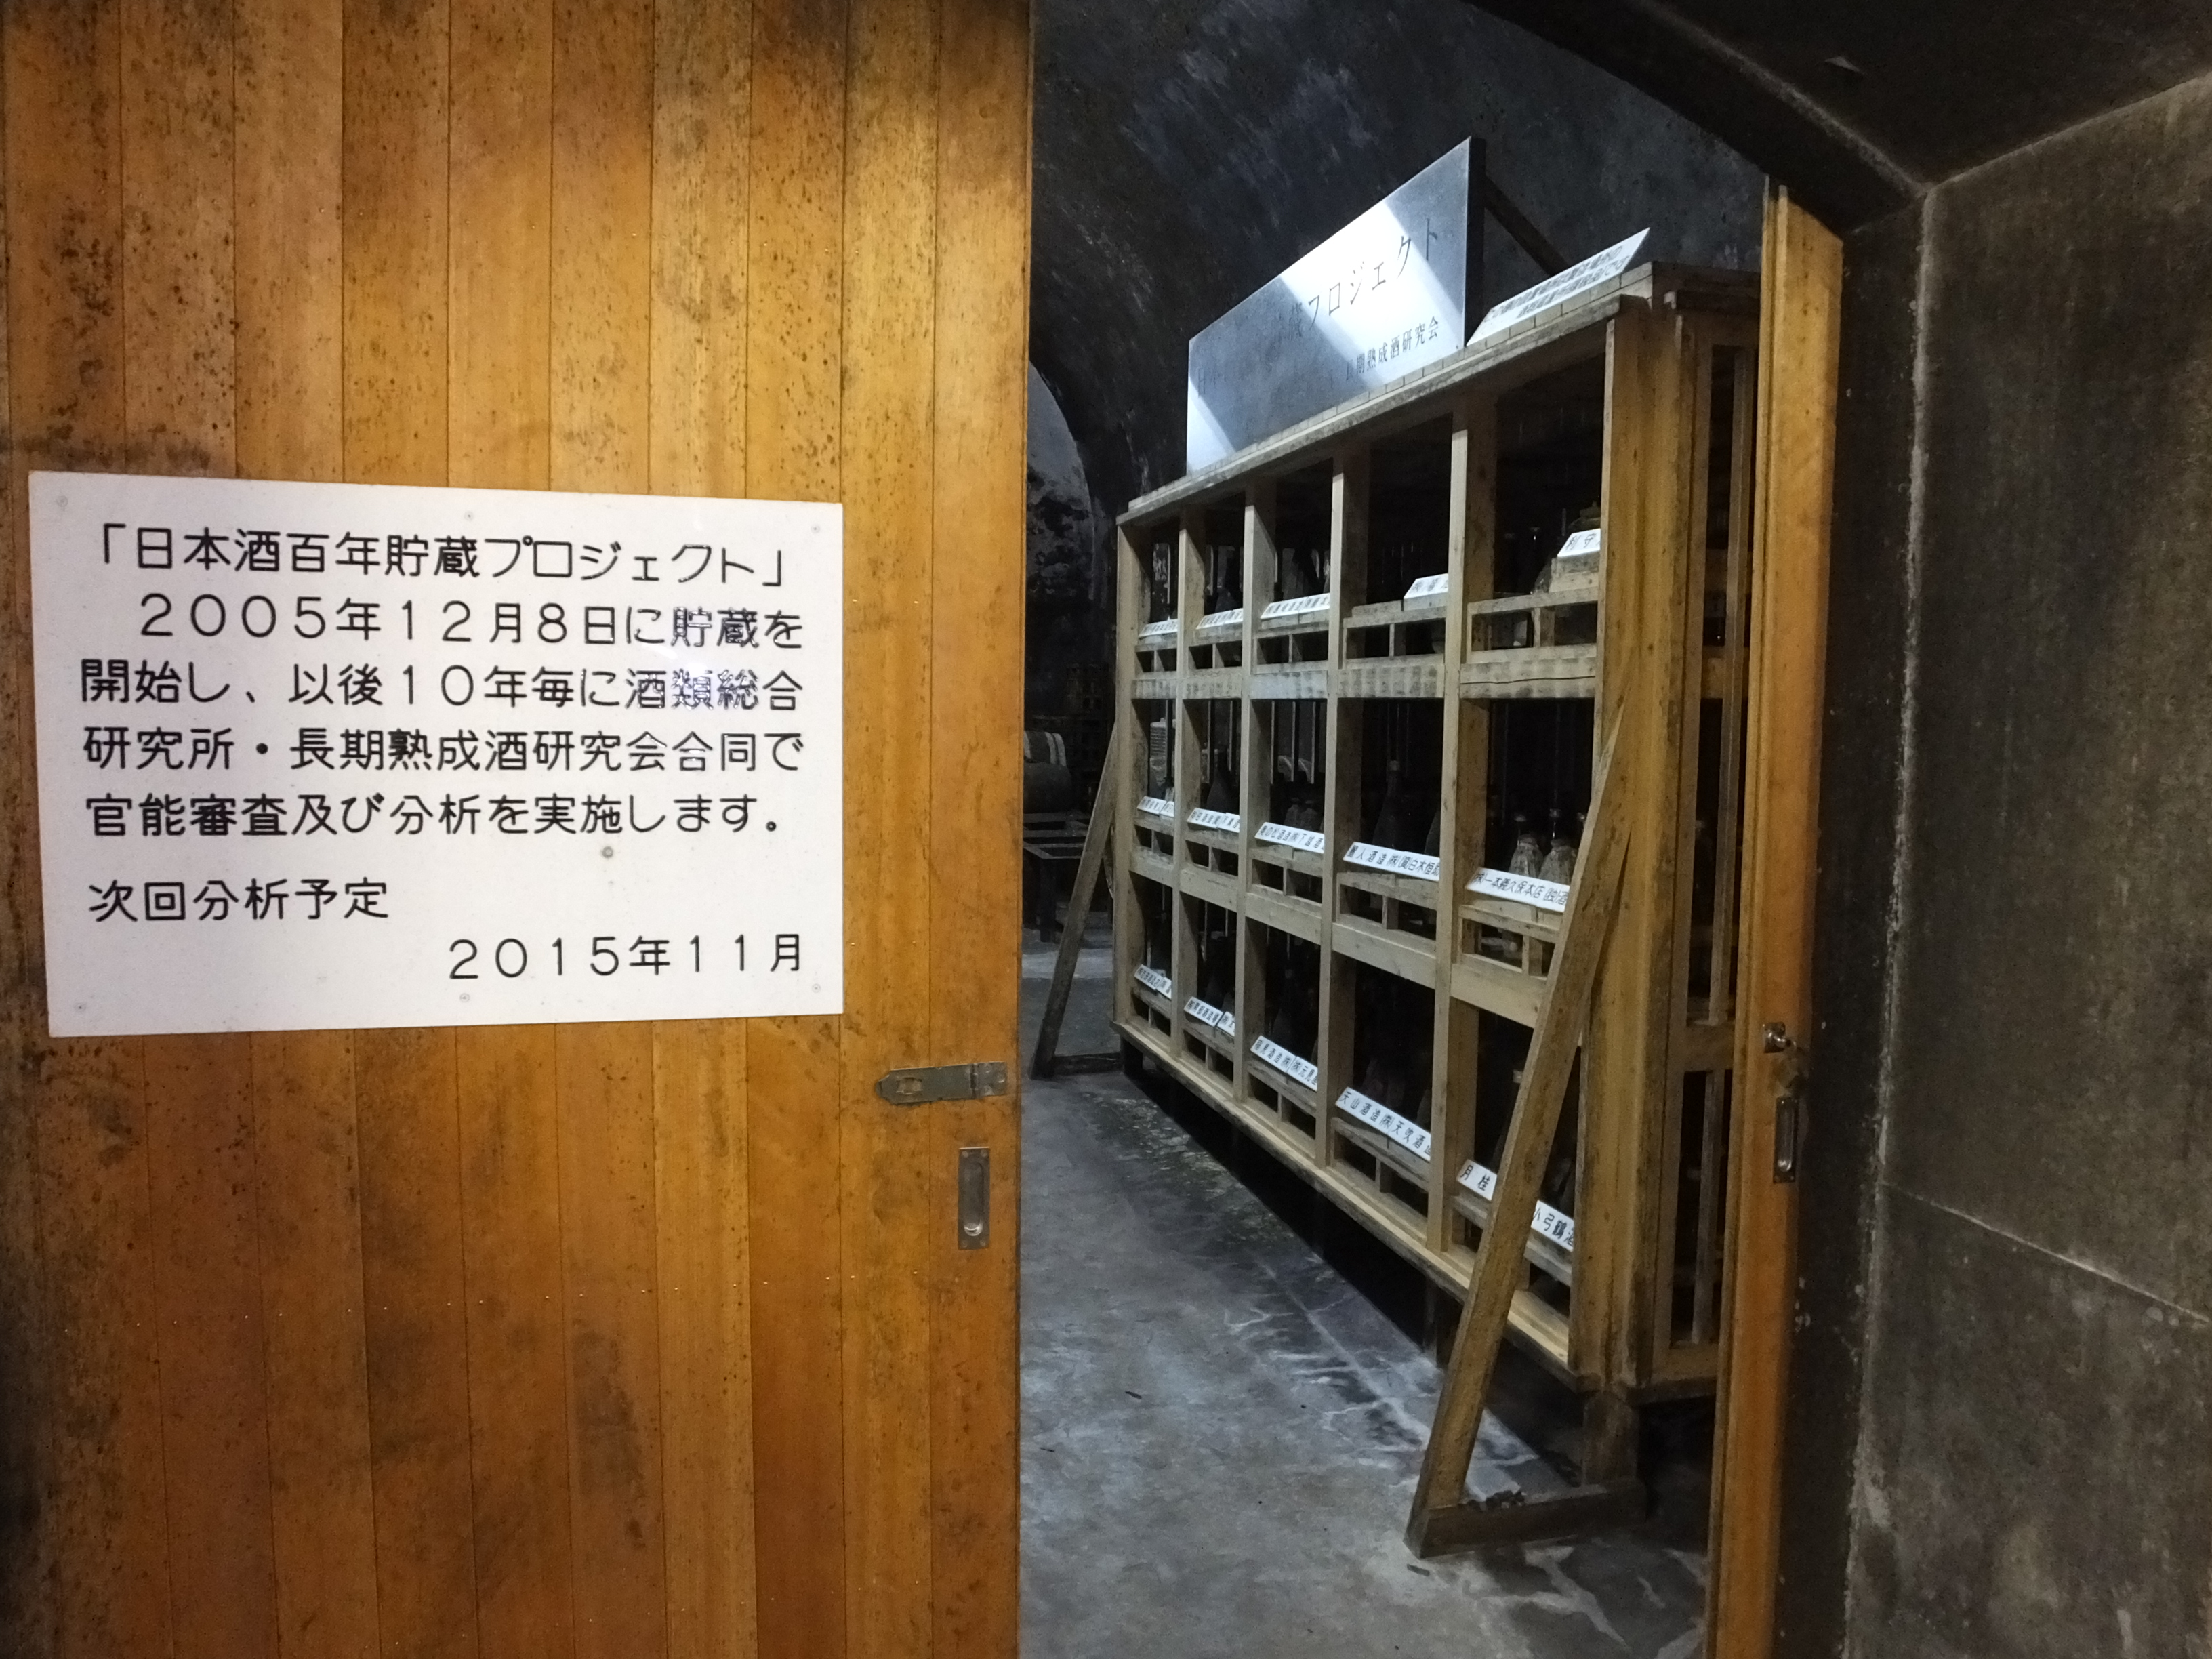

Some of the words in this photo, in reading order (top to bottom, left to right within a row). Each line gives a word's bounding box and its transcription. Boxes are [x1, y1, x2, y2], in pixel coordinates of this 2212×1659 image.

[104, 523, 781, 587] 「日本酒百年貯蔵プロジェクト」
[141, 593, 802, 649] 2005年12月8日に貯蔵を
[81, 659, 802, 710] 開始し、以後10年毎に酒類総合
[83, 726, 804, 771] 研究所・長期熟成酒研究会合同で
[86, 793, 777, 836] 官能審査及び分析を実施します。
[89, 877, 388, 922] 次回分析予定
[449, 934, 799, 979] 2015年11月
